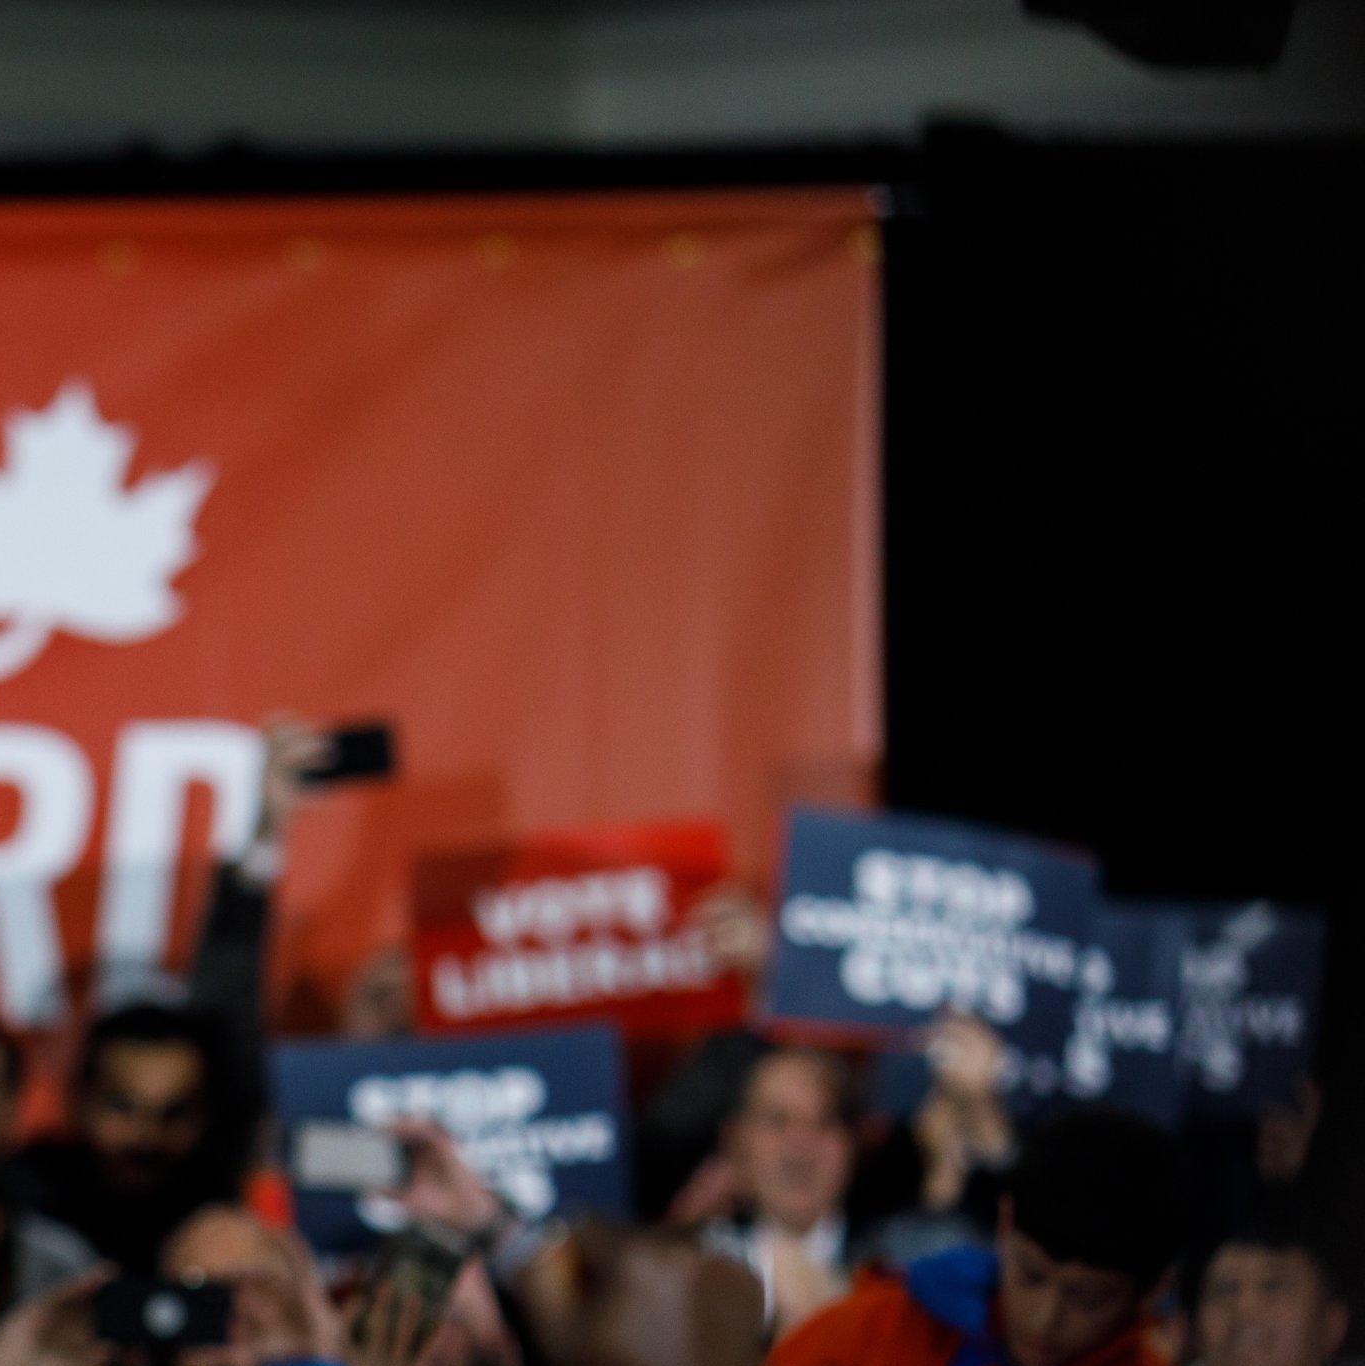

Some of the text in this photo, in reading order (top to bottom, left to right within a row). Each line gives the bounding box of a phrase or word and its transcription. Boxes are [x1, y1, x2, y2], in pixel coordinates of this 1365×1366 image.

[474, 869, 667, 947] VOTE
[857, 851, 1030, 922] STOP
[844, 941, 1021, 1018] CUTS
